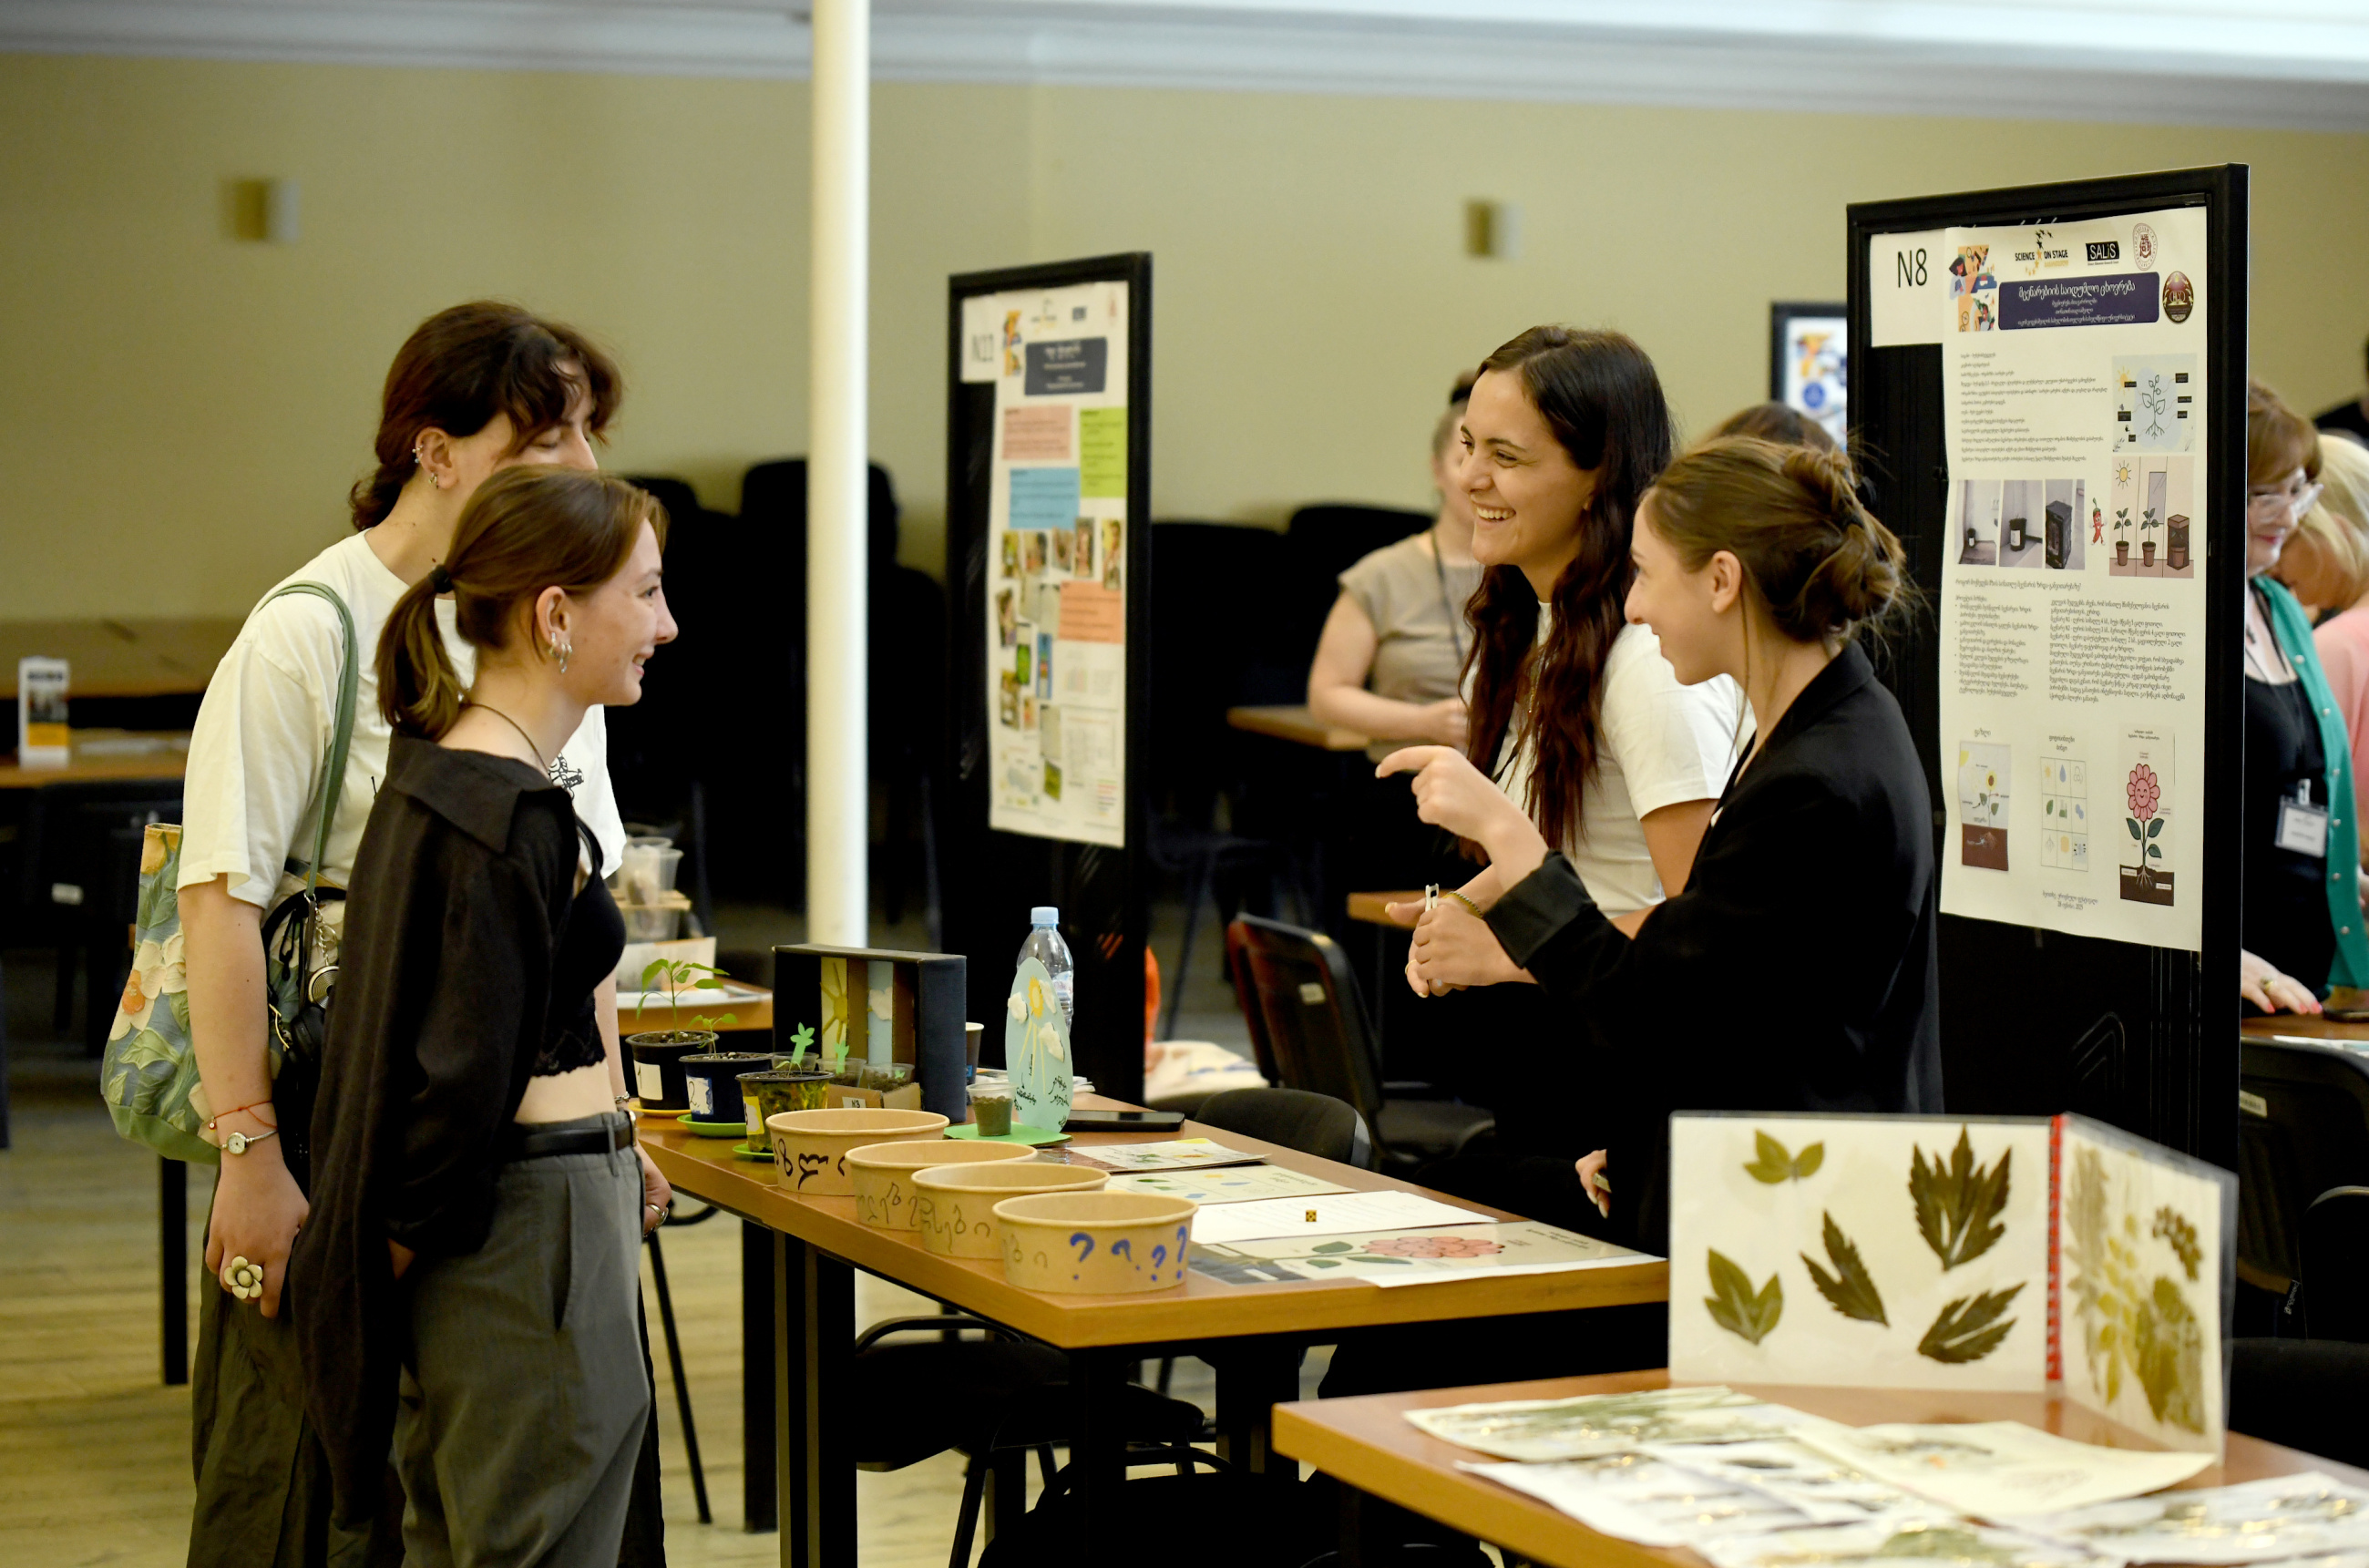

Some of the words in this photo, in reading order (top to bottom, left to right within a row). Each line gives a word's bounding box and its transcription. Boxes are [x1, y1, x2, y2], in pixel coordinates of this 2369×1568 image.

[1897, 248, 1928, 288] N8
[2015, 252, 2036, 261] SCIENCE
[2044, 251, 2052, 260] ON
[2053, 249, 2068, 259] STAGE
